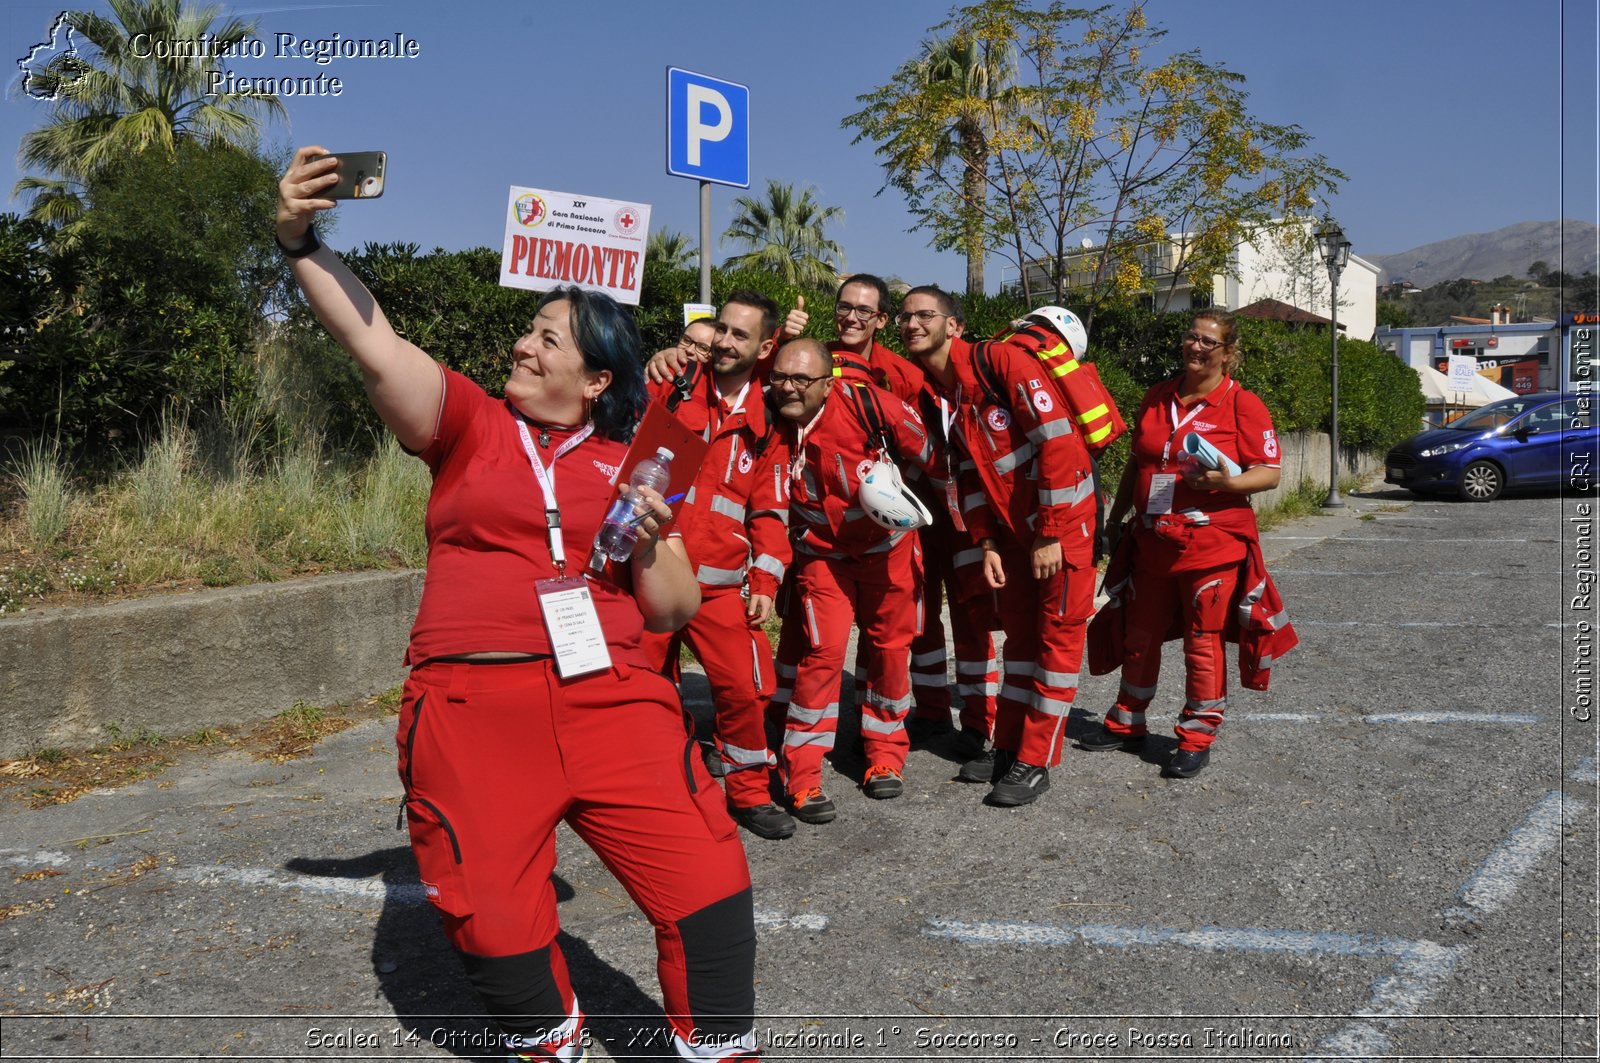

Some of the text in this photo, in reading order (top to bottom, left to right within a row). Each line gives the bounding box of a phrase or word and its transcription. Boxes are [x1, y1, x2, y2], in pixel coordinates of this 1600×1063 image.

[687, 83, 733, 167] P
[573, 200, 587, 208] XXV
[552, 210, 604, 223] Gara Nazionale
[556, 222, 575, 230] Primo
[577, 225, 606, 234] Soccorso
[509, 235, 639, 290] PIEMONTE
